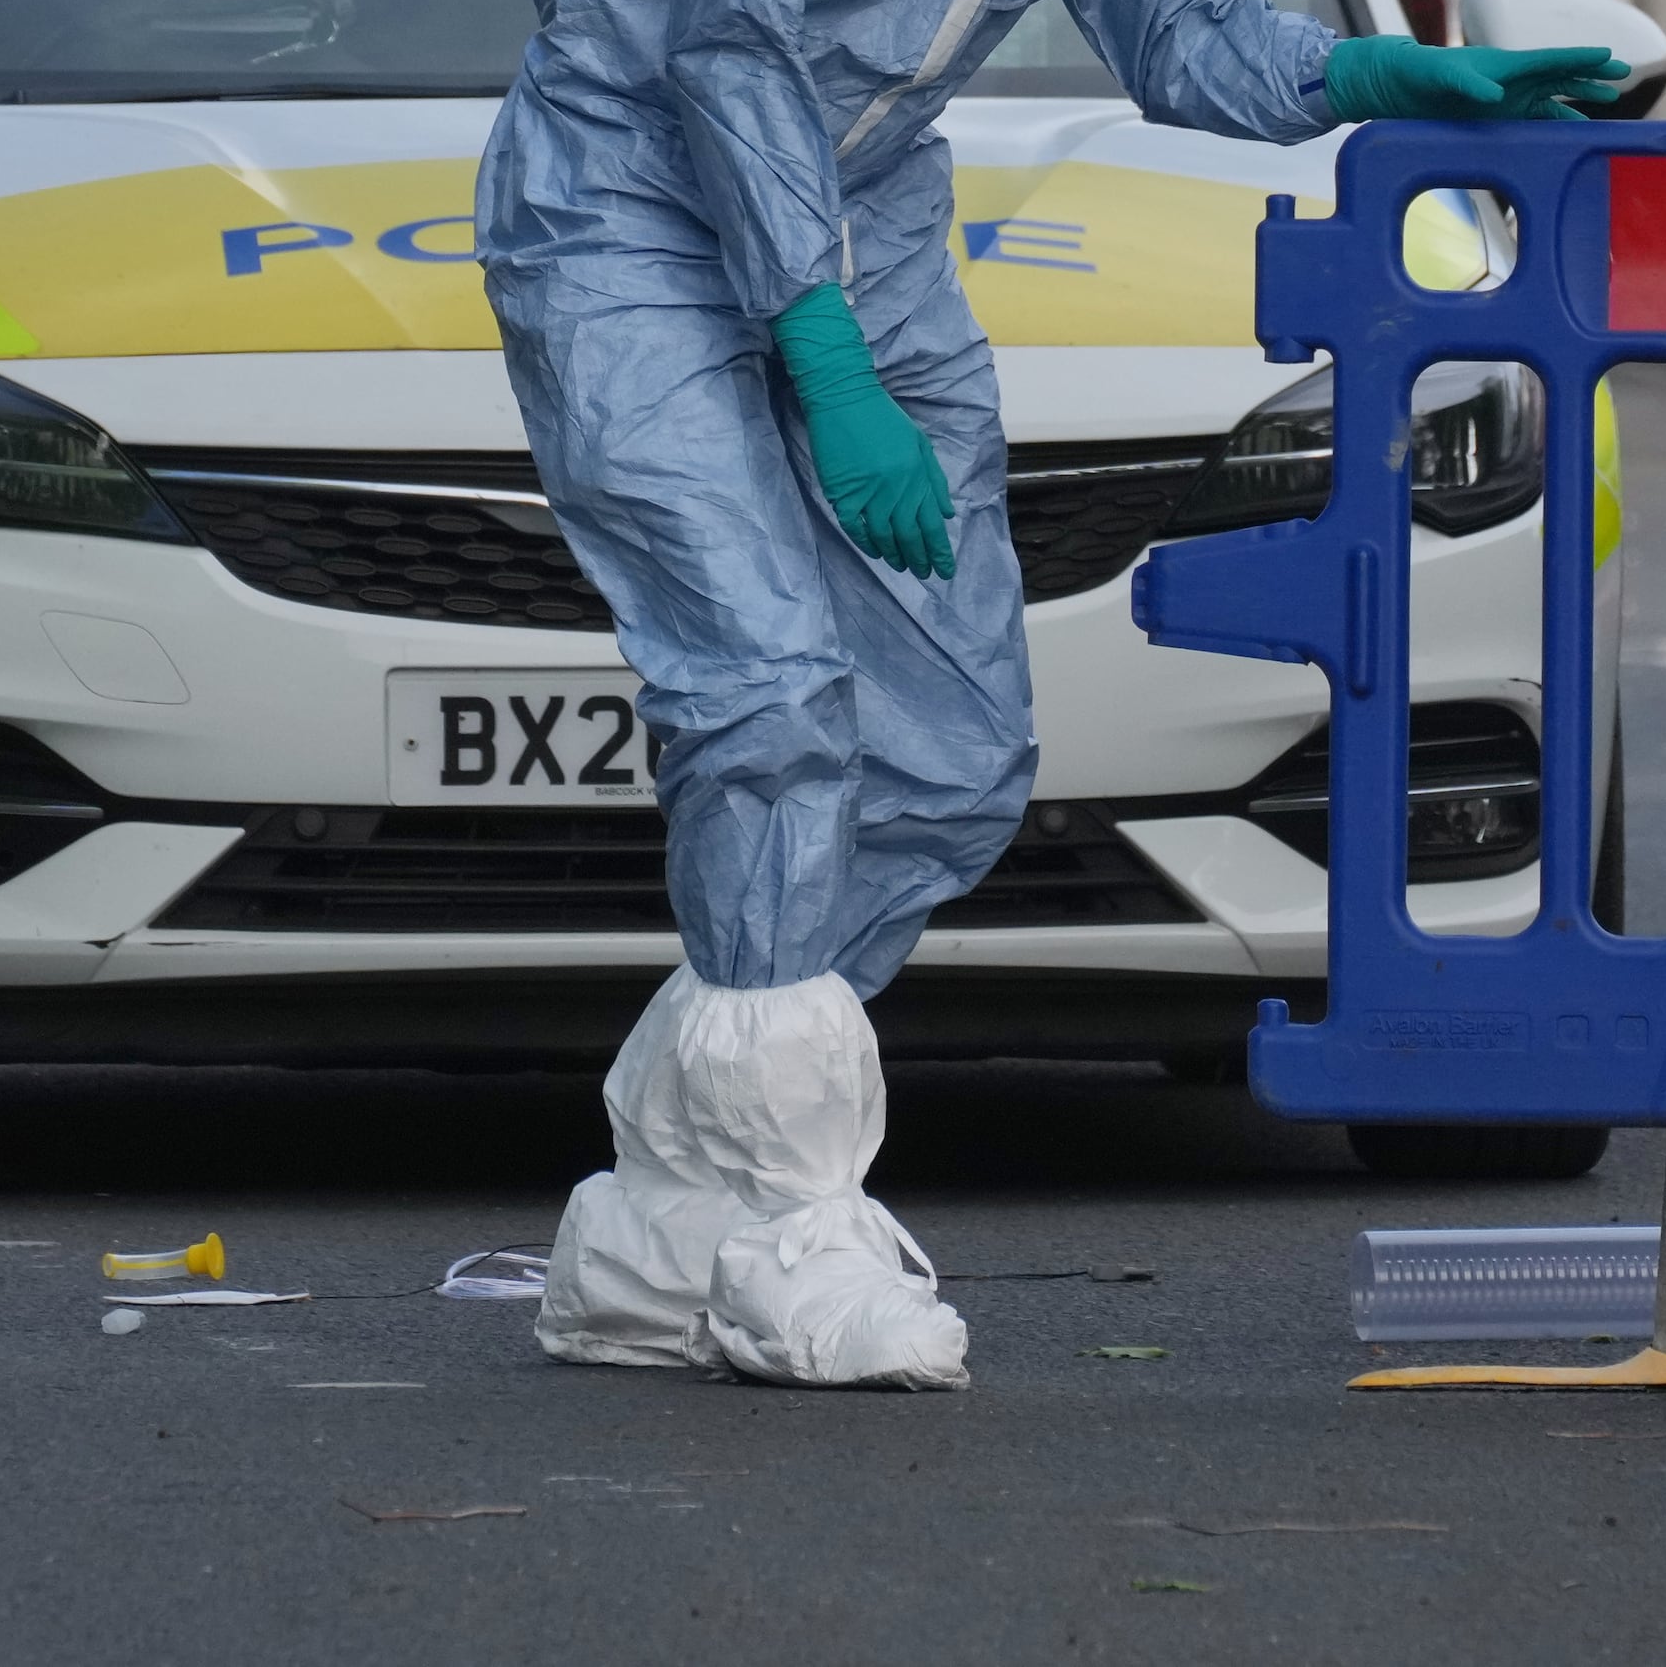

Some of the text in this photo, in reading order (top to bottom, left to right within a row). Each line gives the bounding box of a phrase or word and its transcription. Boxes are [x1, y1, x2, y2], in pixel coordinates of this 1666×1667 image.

[439, 695, 660, 786] BX2
[1062, 898, 1097, 917] Tyvek
[1369, 1012, 1519, 1037] Avalon Barrier
